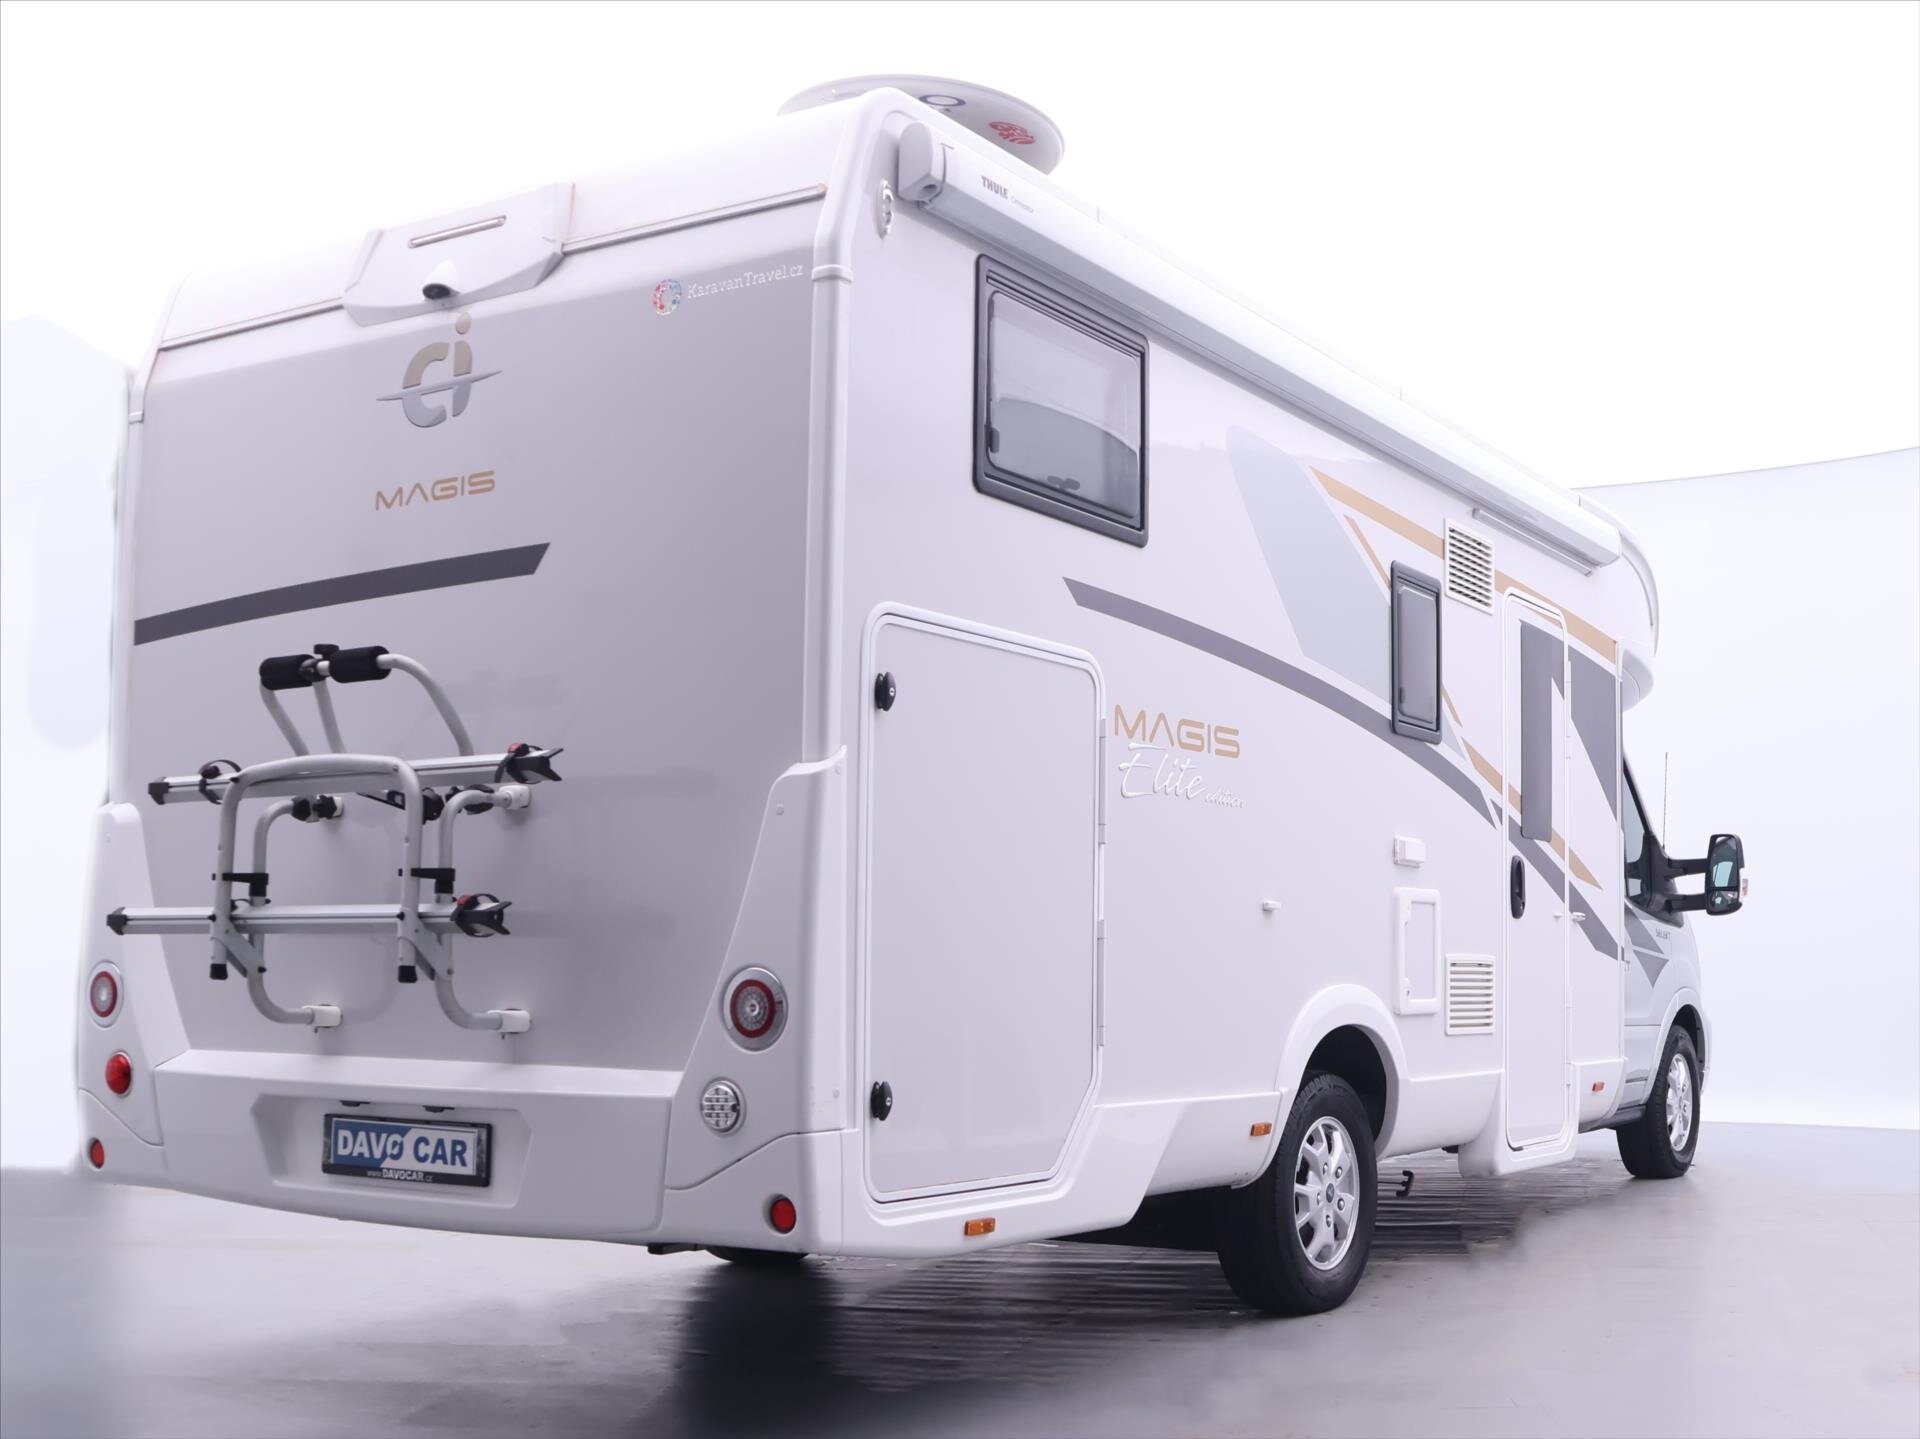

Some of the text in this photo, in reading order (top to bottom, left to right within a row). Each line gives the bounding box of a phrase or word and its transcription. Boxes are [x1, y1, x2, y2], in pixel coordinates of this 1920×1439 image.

[687, 265, 804, 299] KaravanTravel.cz
[375, 470, 496, 511] MAGIS
[1114, 704, 1241, 759] MAGIS
[1118, 742, 1206, 800] Elite
[413, 1136, 468, 1167] CAR
